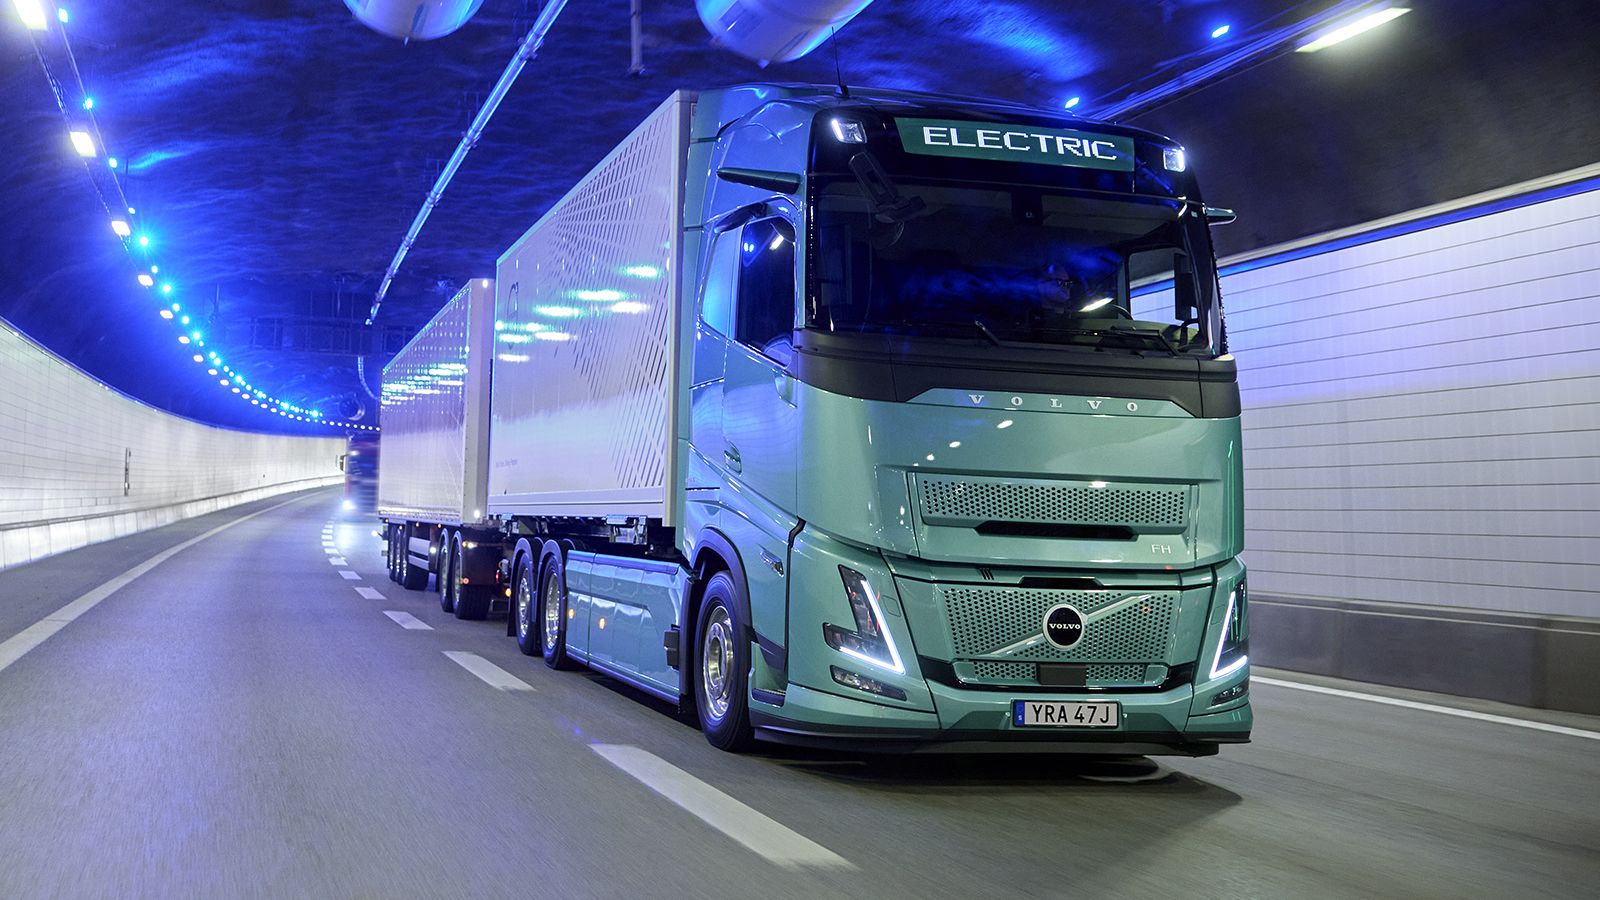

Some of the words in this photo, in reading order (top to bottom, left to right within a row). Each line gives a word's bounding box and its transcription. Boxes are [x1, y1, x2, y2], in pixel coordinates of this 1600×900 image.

[922, 126, 1117, 160] ELECTRIC
[968, 394, 1138, 411] VOLVO
[1151, 544, 1172, 554] FH
[1032, 704, 1068, 723] YRA
[1074, 705, 1110, 724] 47J
